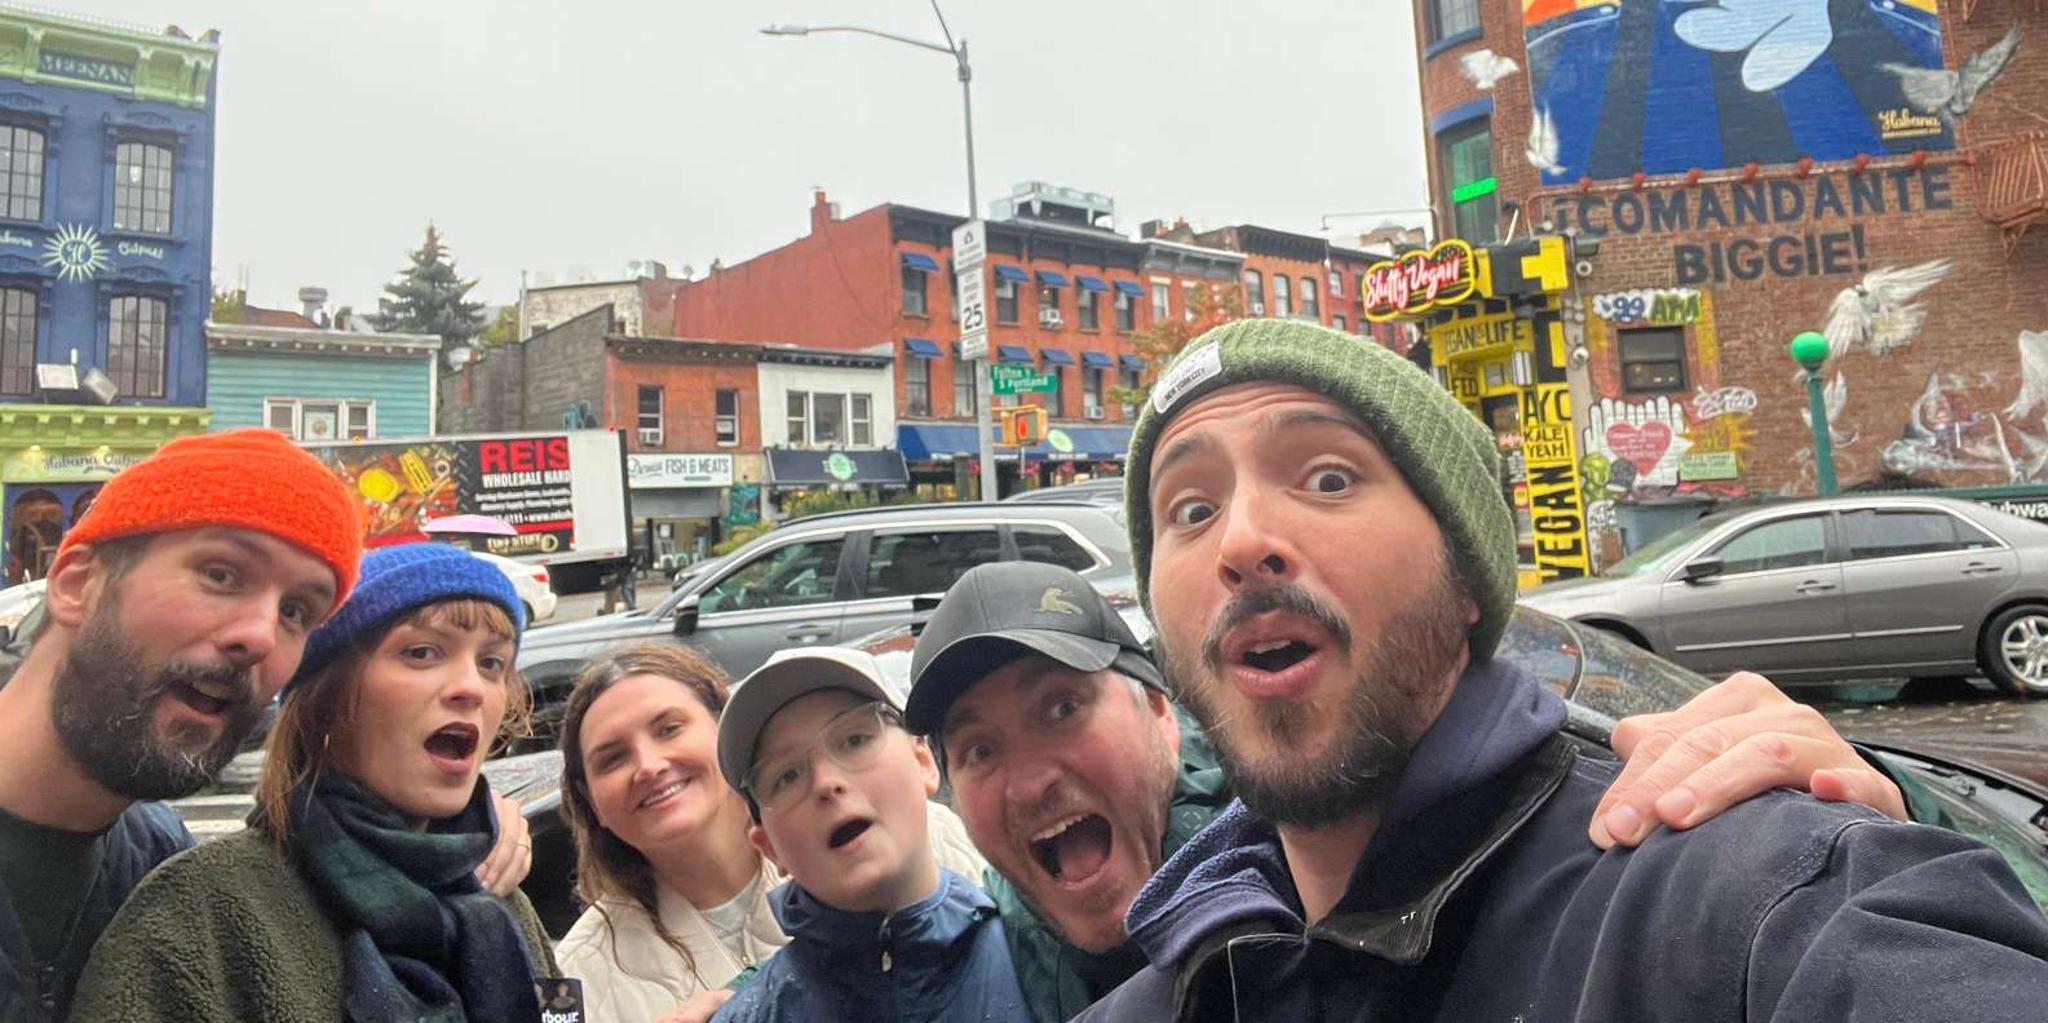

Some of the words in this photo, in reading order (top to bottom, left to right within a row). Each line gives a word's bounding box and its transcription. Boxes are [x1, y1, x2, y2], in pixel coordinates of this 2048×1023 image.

[1674, 224, 1868, 284] BIGGIE!
[1366, 264, 1409, 309] Slutty
[1405, 256, 1461, 300] Vegan
[963, 303, 983, 331] 25
[481, 438, 569, 473] REIS
[1527, 442, 1565, 458] YEAH
[482, 471, 543, 489] WHOLESALE
[665, 458, 687, 475] FISH
[699, 458, 730, 475] MEATS
[1529, 464, 1585, 580] VEGAN
